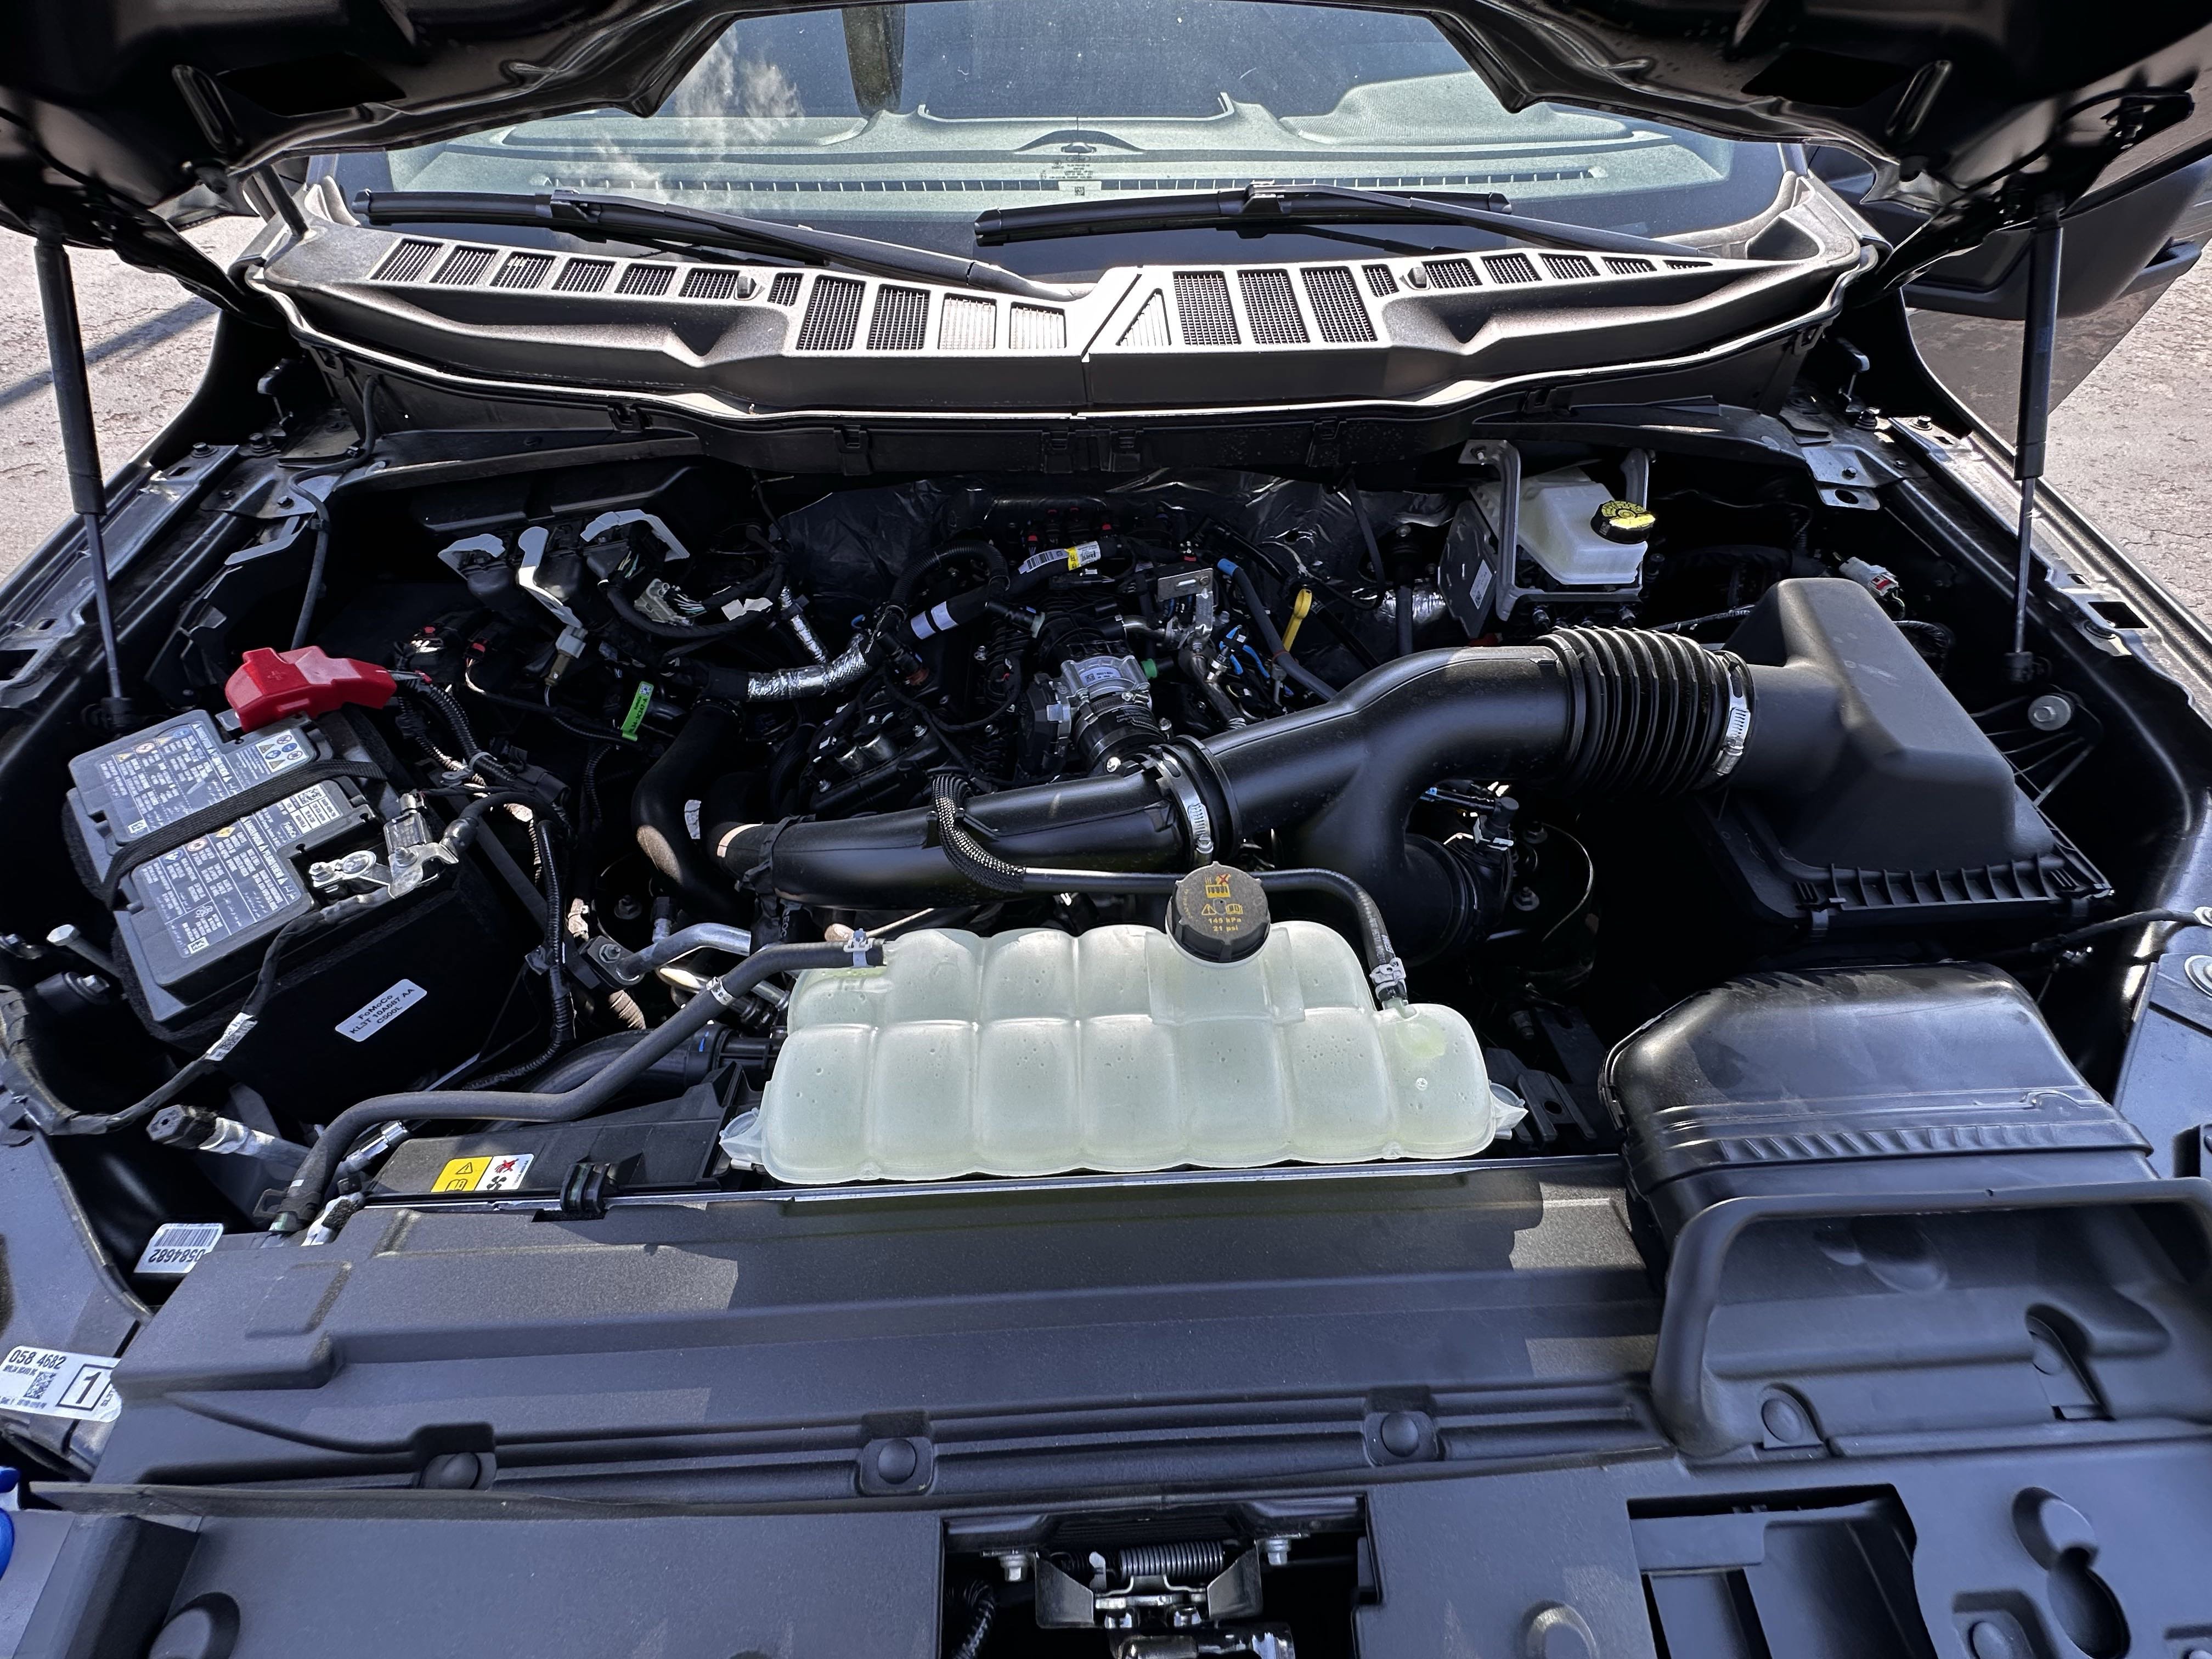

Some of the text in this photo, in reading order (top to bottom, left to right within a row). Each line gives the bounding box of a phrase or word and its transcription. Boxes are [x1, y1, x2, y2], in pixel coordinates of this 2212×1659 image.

[349, 1018, 371, 1034] KL3T
[401, 989, 415, 998] AA
[358, 995, 393, 1019] FoMoCo
[148, 1249, 206, 1263] 0584682
[9, 1350, 67, 1369] 058 4682
[76, 1372, 102, 1404] 1
